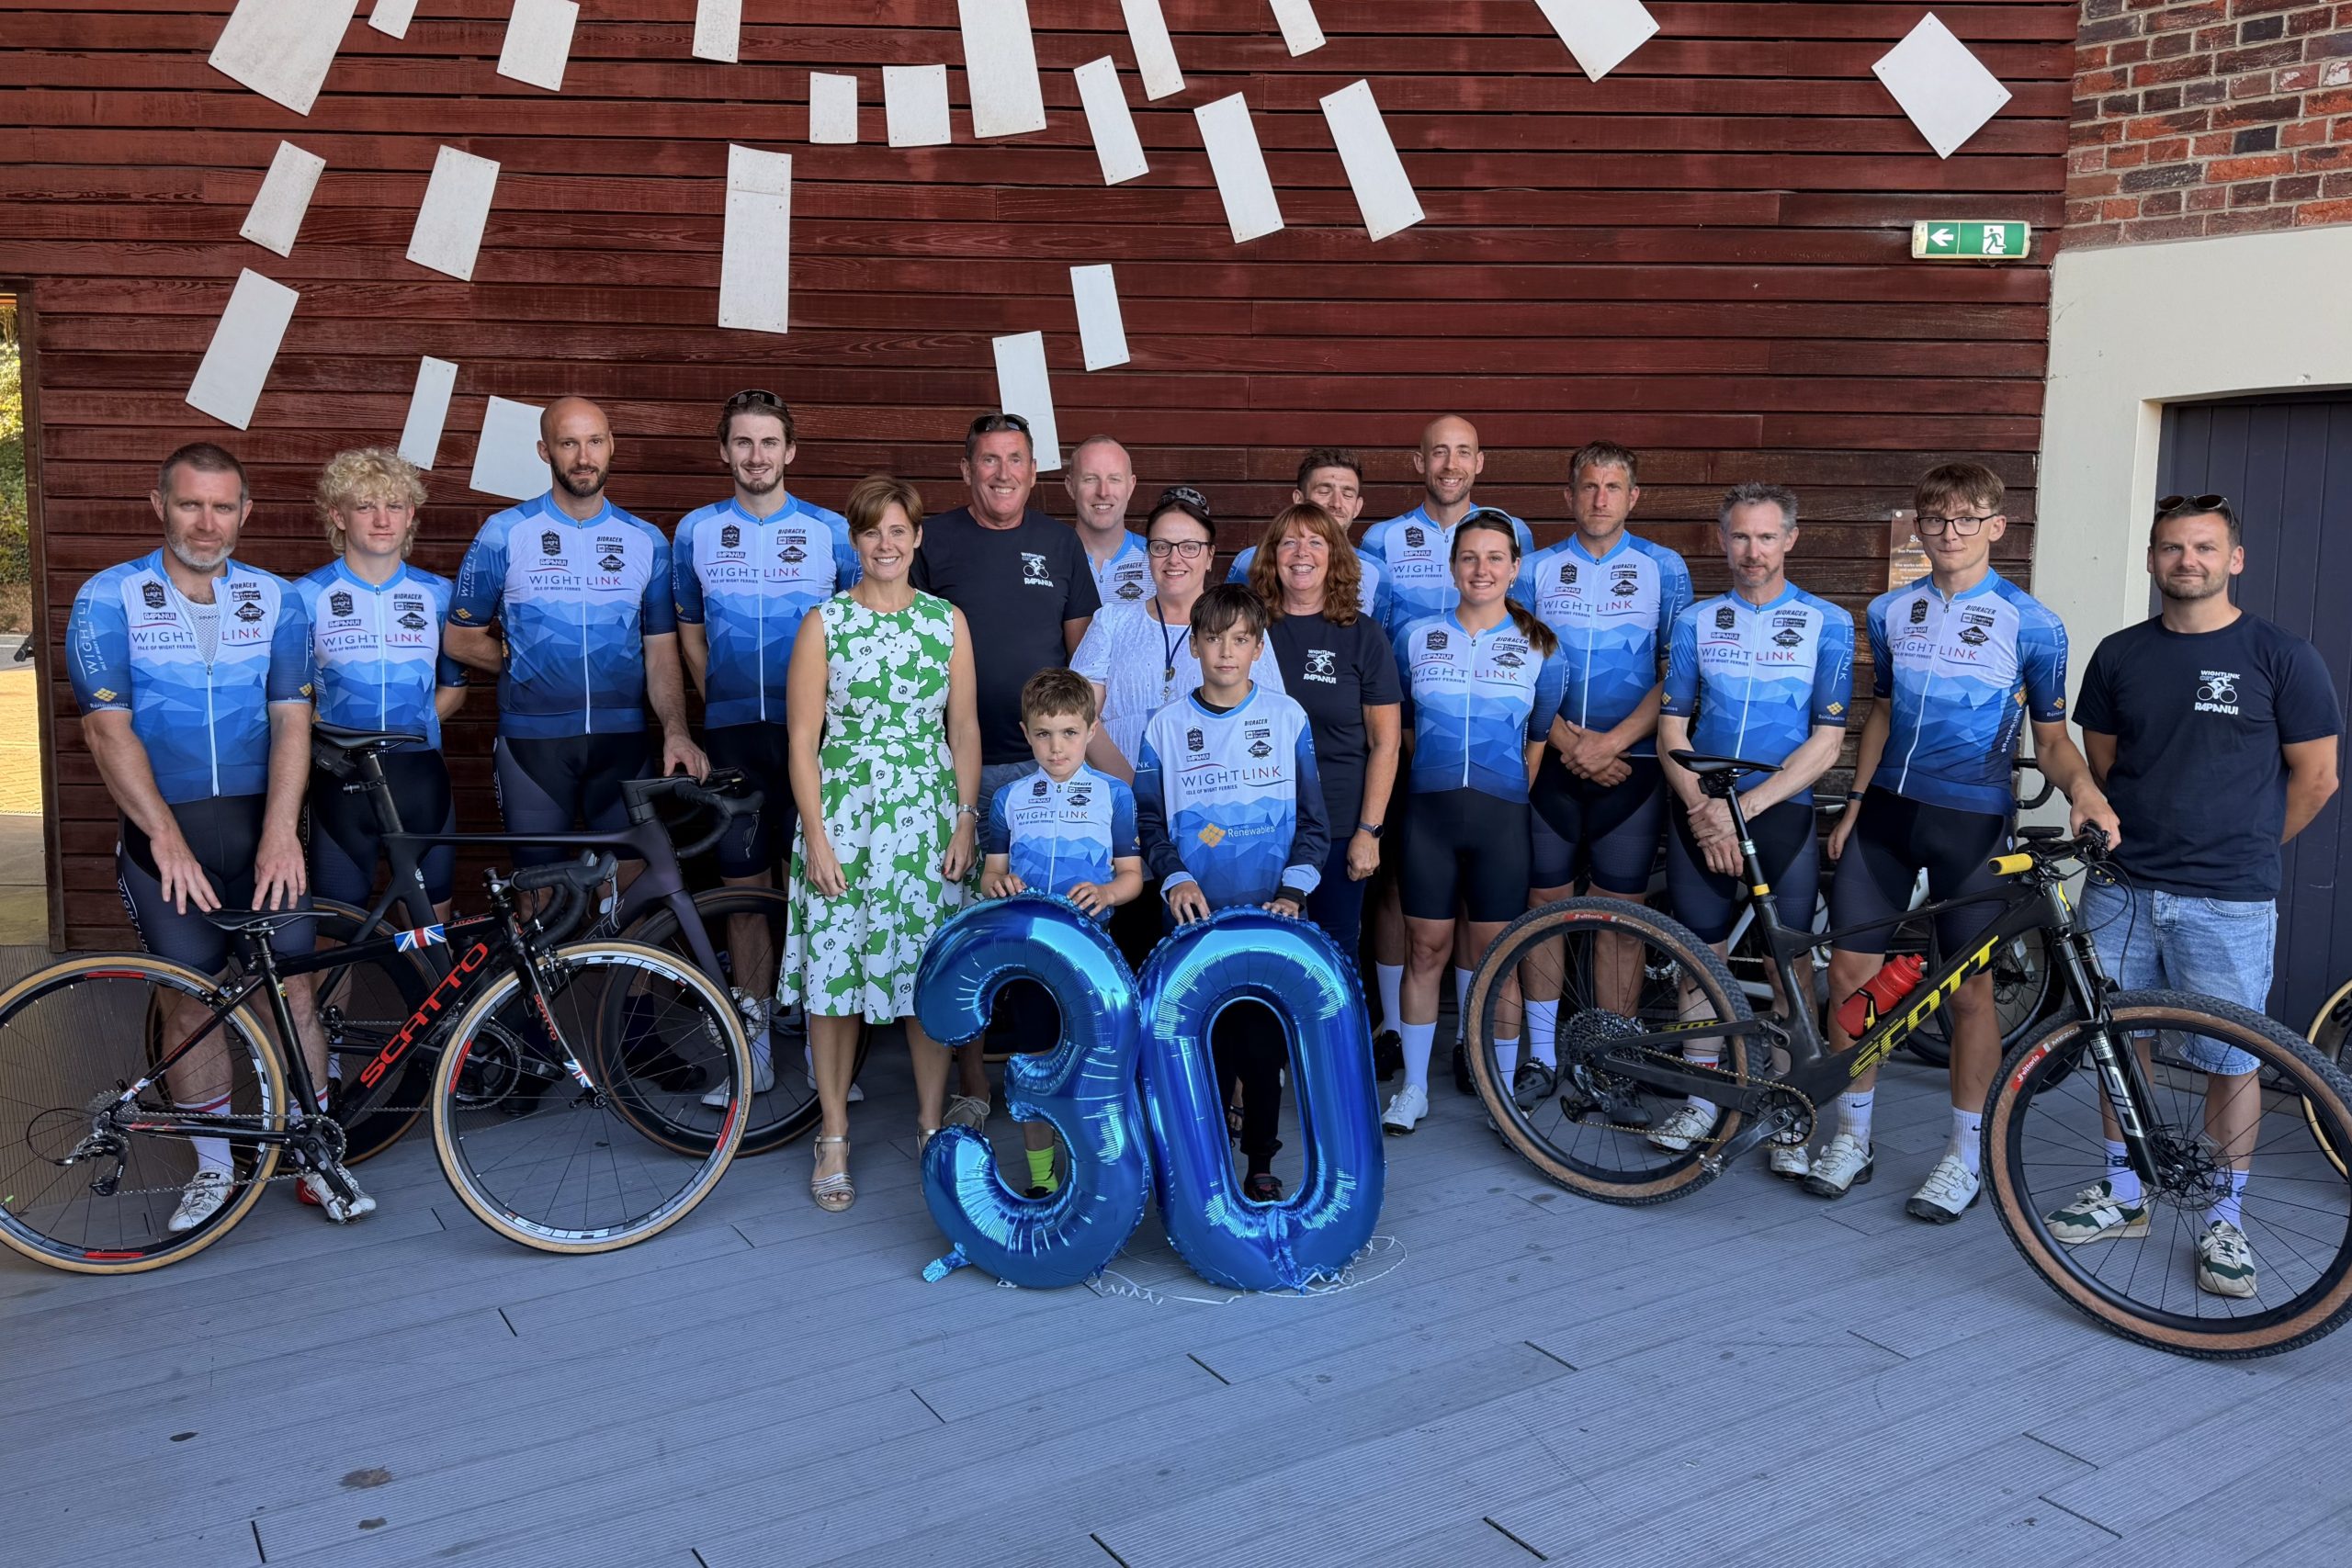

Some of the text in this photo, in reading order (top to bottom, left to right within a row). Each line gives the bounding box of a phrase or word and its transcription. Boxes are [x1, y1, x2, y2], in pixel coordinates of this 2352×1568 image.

[1965, 605, 1996, 615] BIORACER
[1303, 673, 1336, 683] RAPANUI
[2200, 670, 2240, 679] WIGHTLINK
[2195, 702, 2239, 715] RAPANUI
[1244, 718, 1268, 727] BIORACER
[1182, 766, 1282, 787] WIGHTLINK
[1228, 826, 1275, 838] Renewables
[1849, 935, 1999, 1078] SCOTT
[359, 942, 489, 1089] SCATTO
[534, 993, 559, 1041] SCATTO
[1660, 1020, 1720, 1032] SCOT
[2052, 1027, 2082, 1046] MEZCA
[2021, 1055, 2041, 1076] vittoria
